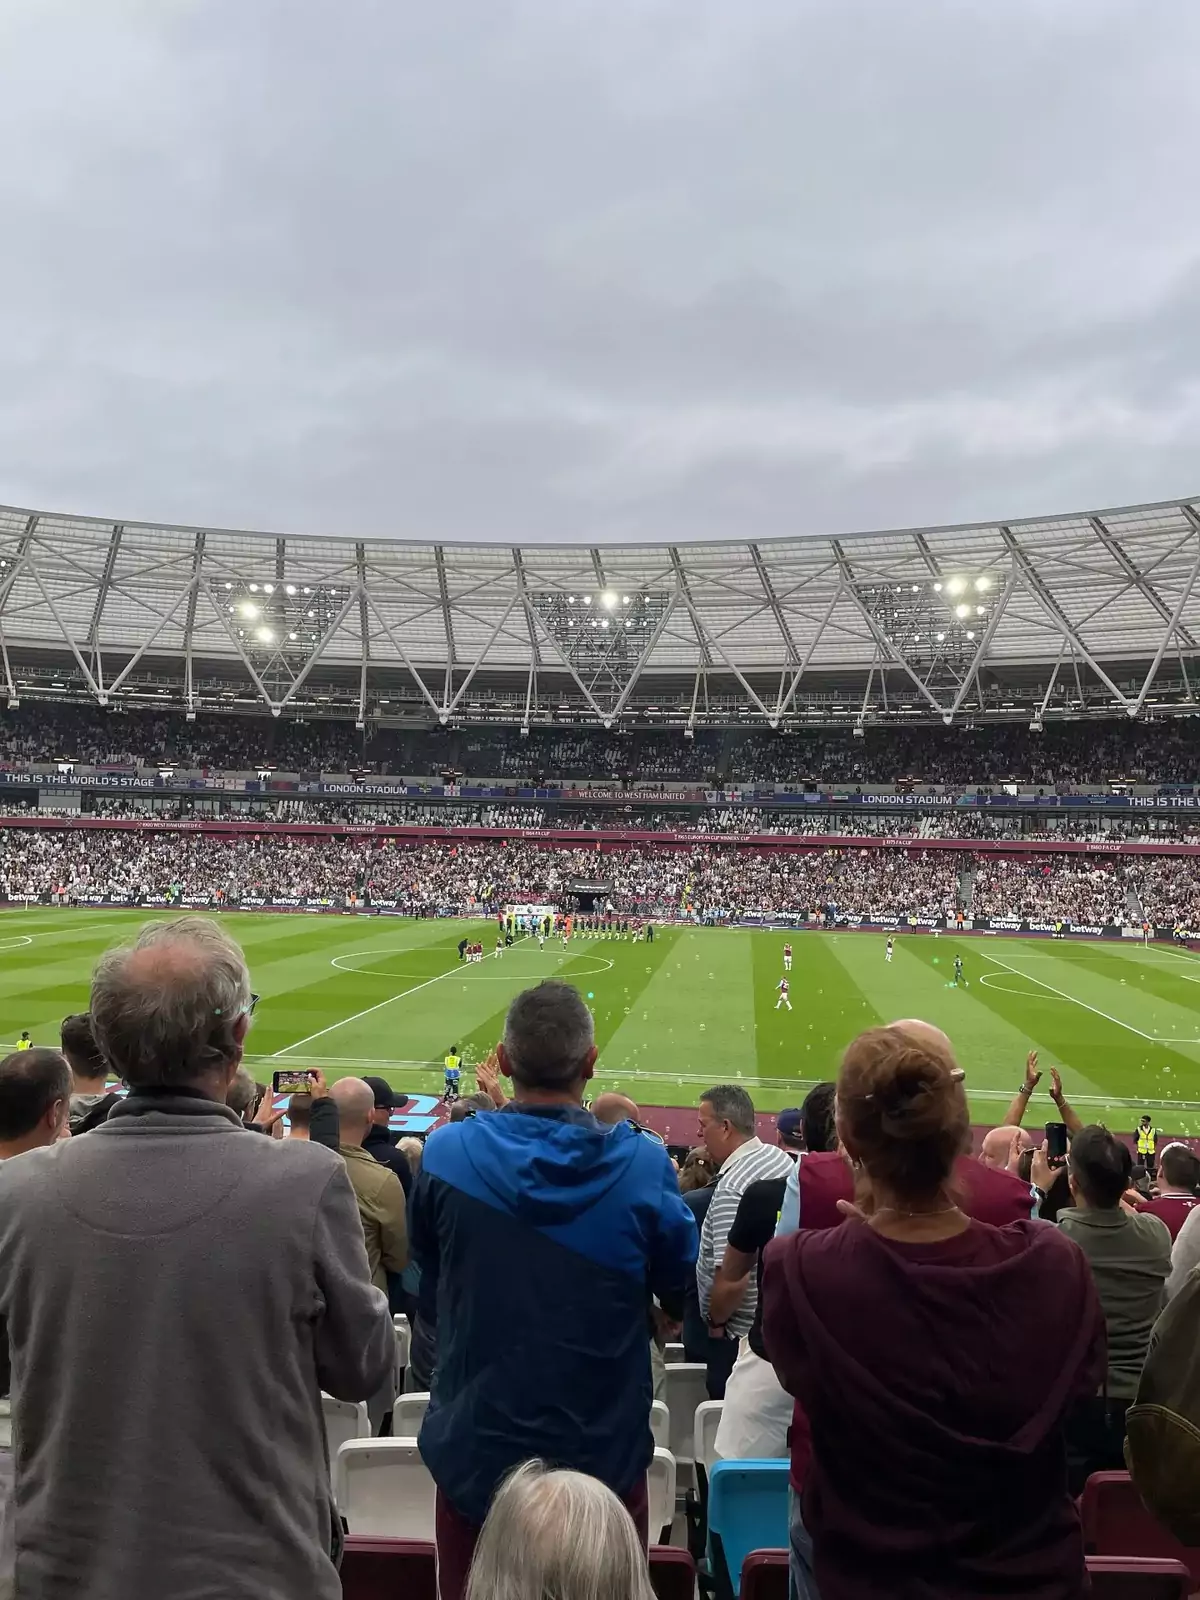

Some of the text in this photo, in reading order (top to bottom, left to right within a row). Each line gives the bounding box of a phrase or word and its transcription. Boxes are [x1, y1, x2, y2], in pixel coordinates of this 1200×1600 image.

[5, 773, 155, 787] THIS IS THE WORLD'S STAGE
[323, 784, 408, 795] LONDON STADIUM
[578, 790, 685, 800] WELCOME TO WEST HAM UNITED
[862, 795, 952, 805] LONDON STADIUM
[1127, 797, 1154, 806] THIS
[1157, 797, 1168, 807] IS
[1170, 797, 1195, 807] THE
[8, 893, 40, 902] betway
[181, 895, 211, 905] betway
[272, 897, 301, 906] betway
[870, 914, 900, 925] betway
[907, 915, 938, 927] btway
[989, 920, 1022, 931] betway
[1029, 921, 1058, 932] betwa
[1069, 924, 1104, 936] betway
